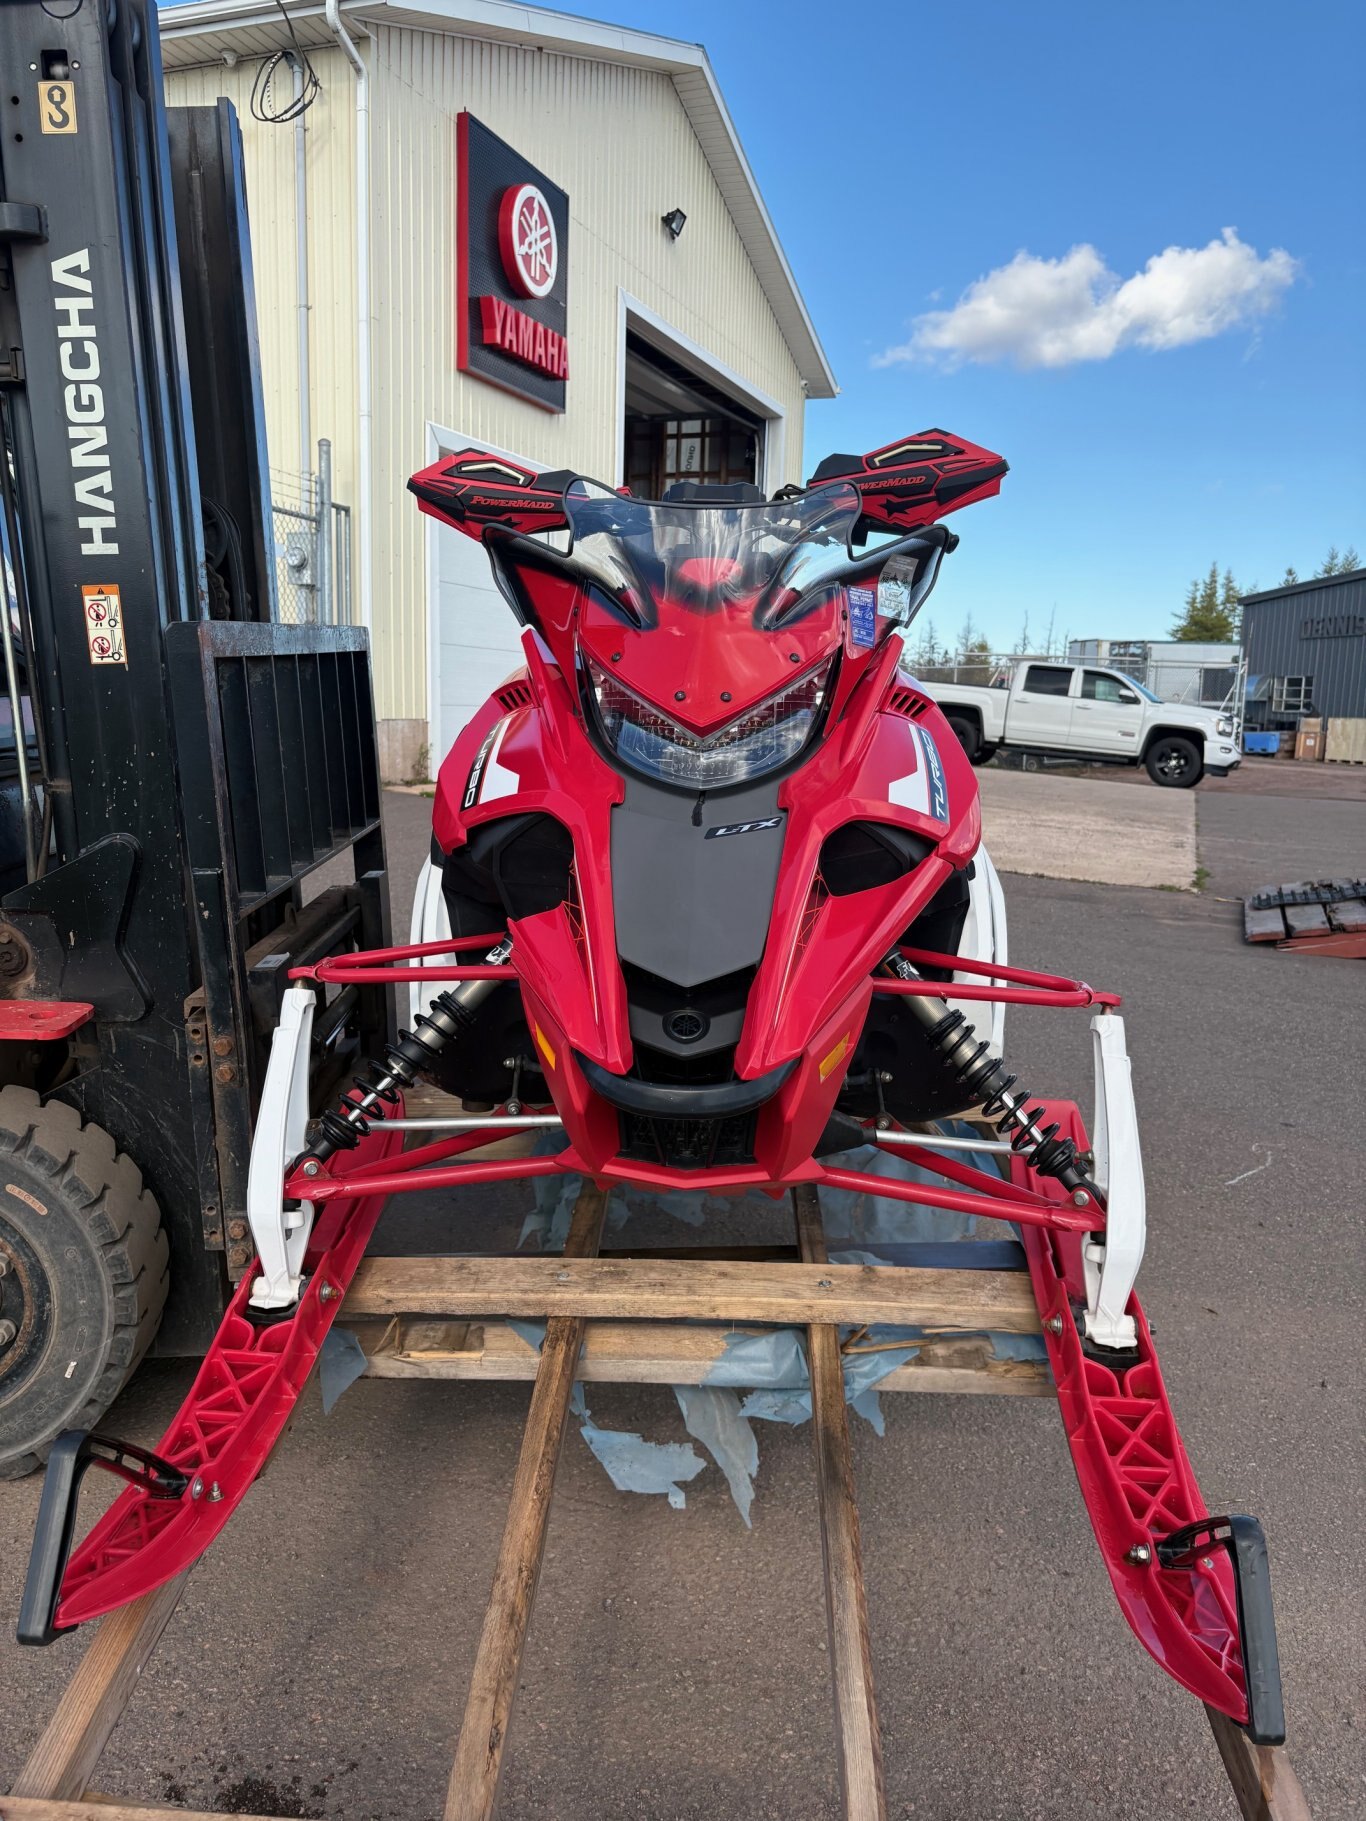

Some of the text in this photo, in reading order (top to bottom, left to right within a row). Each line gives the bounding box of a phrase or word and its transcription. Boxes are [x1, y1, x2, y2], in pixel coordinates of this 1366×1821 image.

[493, 296, 569, 380] YAMAHA
[51, 248, 119, 555] HANGCHA
[464, 722, 501, 808] TURBO
[920, 729, 946, 817] TURBO
